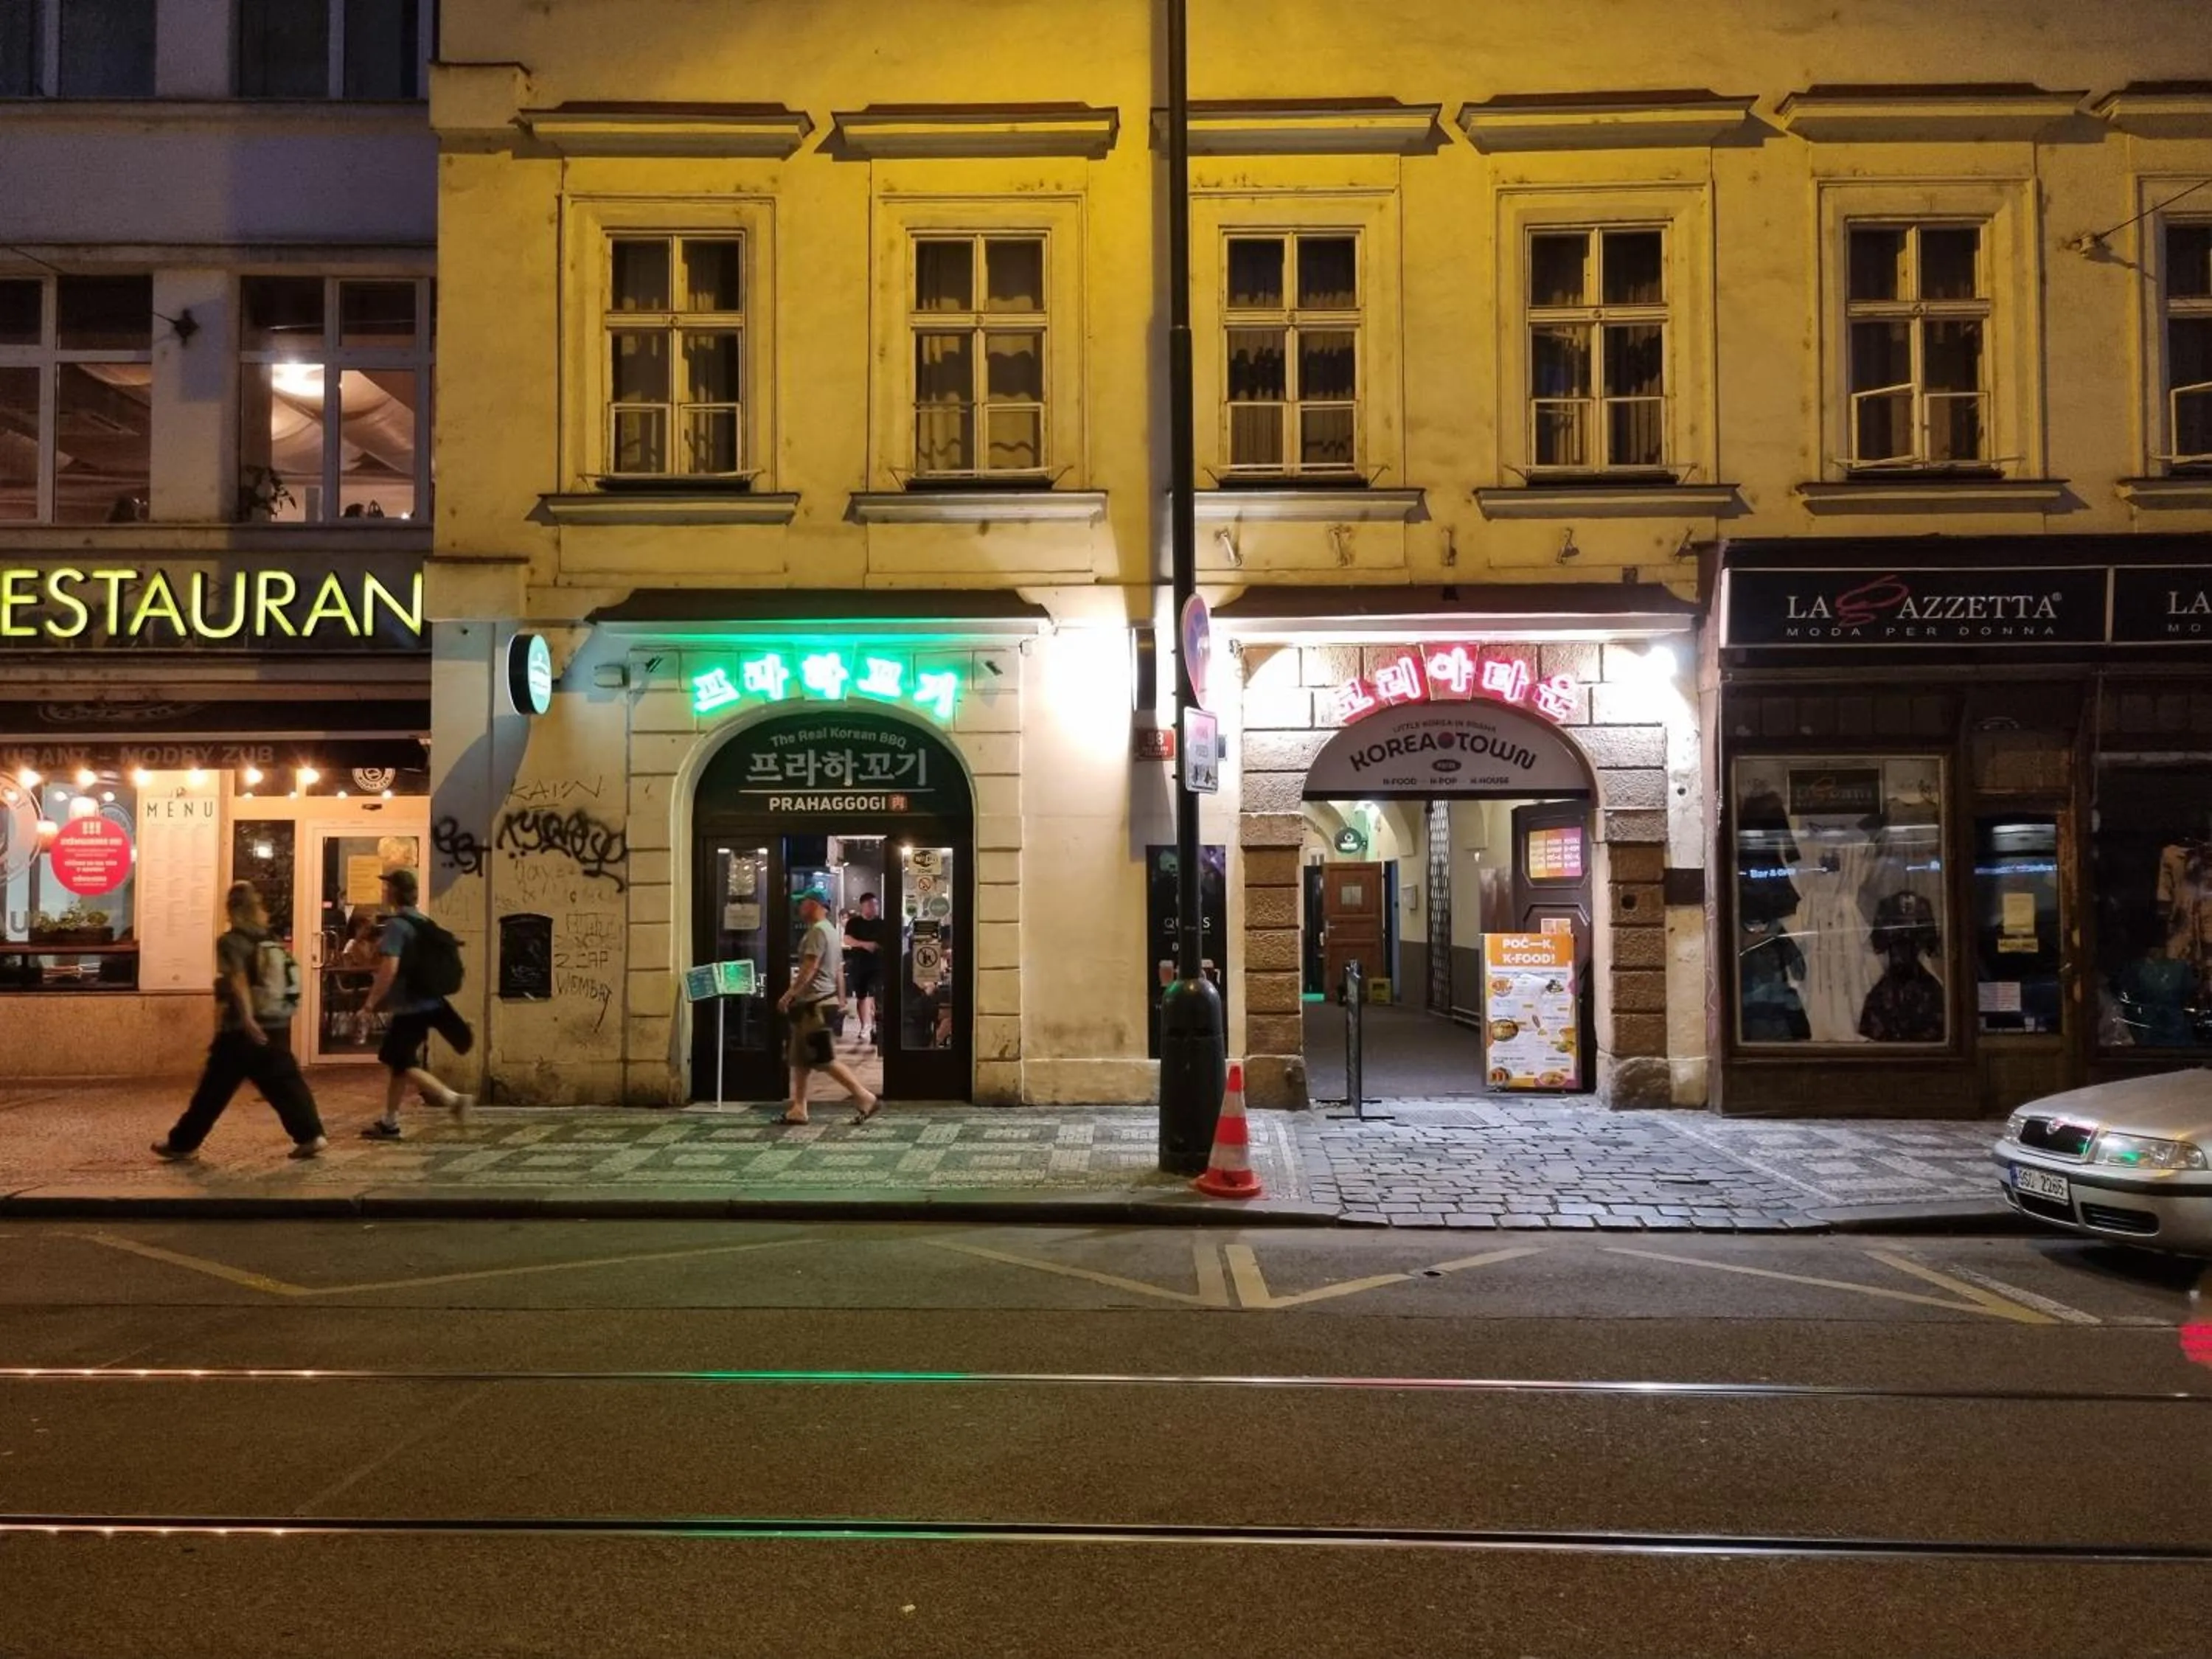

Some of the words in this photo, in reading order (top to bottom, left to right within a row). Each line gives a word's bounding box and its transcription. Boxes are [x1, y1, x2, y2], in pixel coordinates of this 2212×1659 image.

[1, 568, 422, 638] ESTAURAN
[1787, 596, 1832, 619] LA
[2168, 591, 2212, 614] LA
[1787, 627, 1861, 637] MODA
[1886, 627, 1936, 636] PER
[1960, 626, 2054, 636] DONNA
[771, 734, 796, 748] The
[799, 728, 827, 742] Real
[830, 727, 877, 742] Korean
[880, 731, 908, 750] BBQ
[1349, 731, 1436, 771] KOREA
[1455, 731, 1537, 771] TOWN
[147, 801, 213, 818] MENU
[769, 796, 886, 811] PRAHAGGOGI
